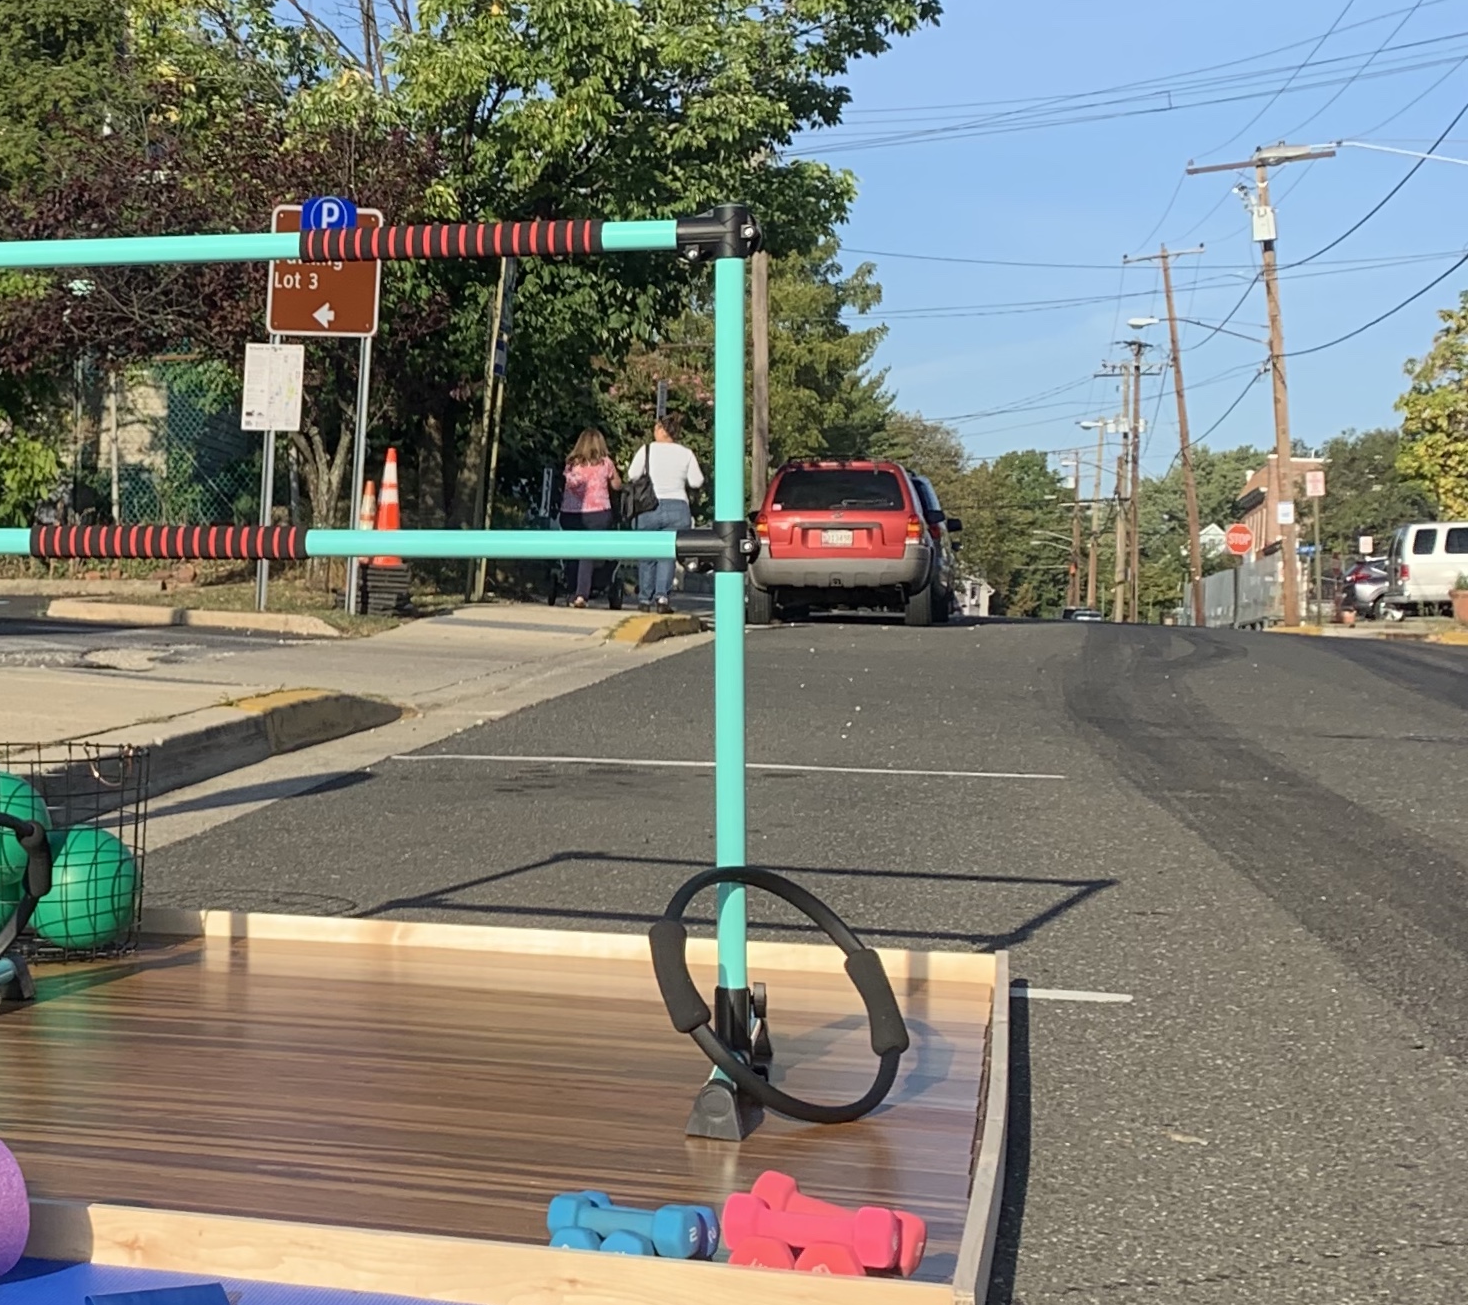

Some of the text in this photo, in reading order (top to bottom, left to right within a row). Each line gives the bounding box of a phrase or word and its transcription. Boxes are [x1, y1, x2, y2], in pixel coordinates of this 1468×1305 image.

[321, 202, 340, 229] P
[274, 271, 319, 290] Lot 3
[1229, 533, 1251, 545] STOP
